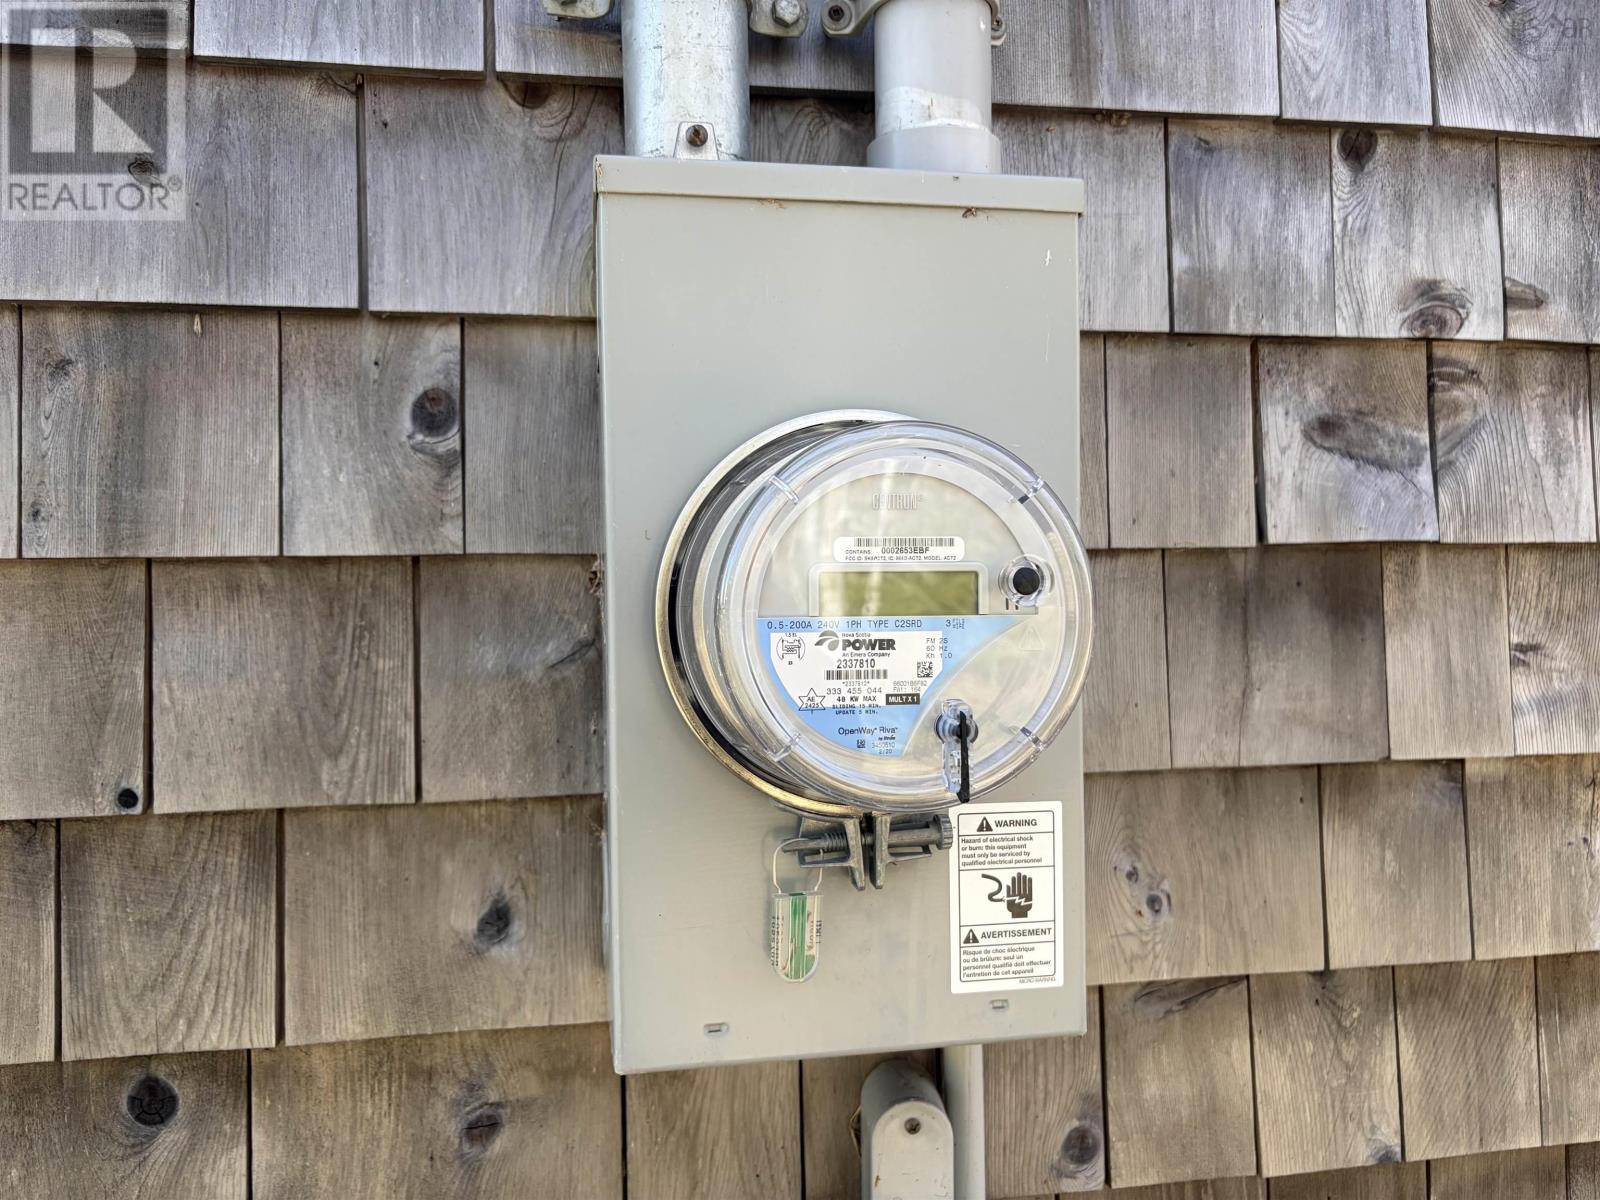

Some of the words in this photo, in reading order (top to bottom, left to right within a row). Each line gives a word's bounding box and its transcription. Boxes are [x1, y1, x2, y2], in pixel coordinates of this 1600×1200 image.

[767, 620, 812, 630] 0.5-200A
[817, 620, 840, 629] 240V
[846, 620, 862, 629] 1PH
[868, 620, 888, 628] TYPE
[894, 620, 922, 628] C2SRD
[842, 638, 896, 651] POWER
[836, 659, 876, 669] 2337810
[994, 818, 1037, 828] WARNING
[981, 928, 1052, 939] AVERTISSEMENT
